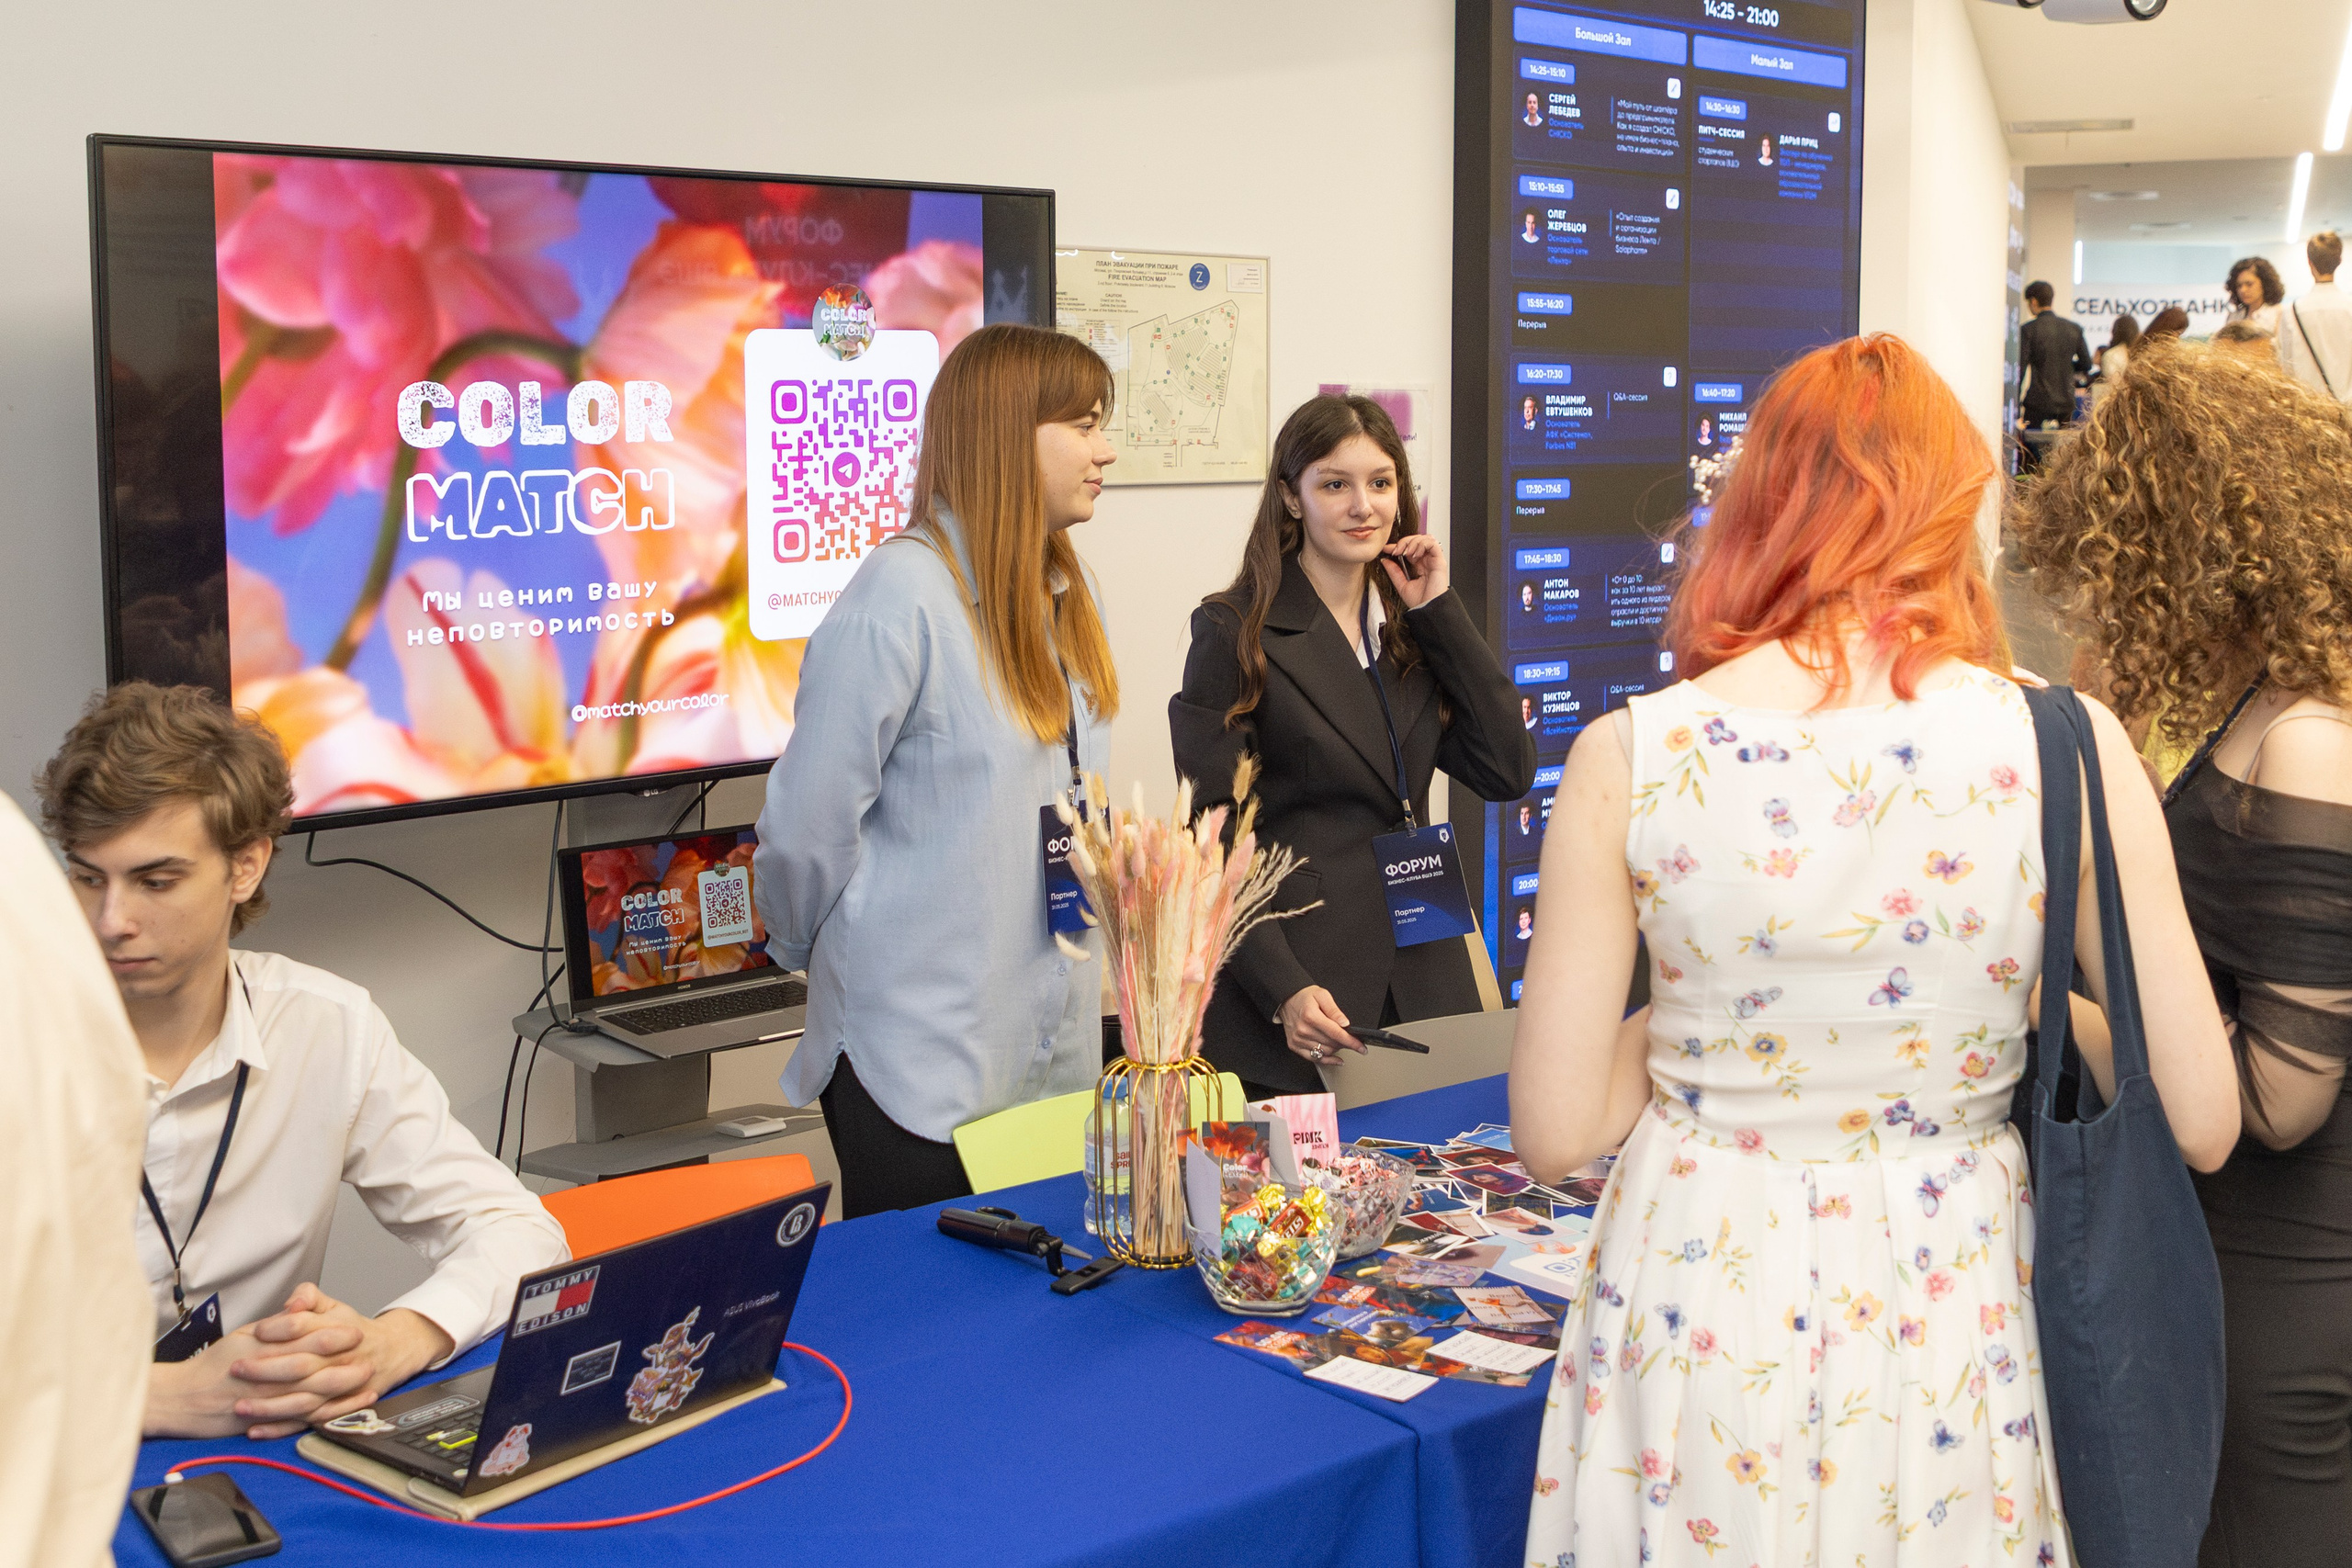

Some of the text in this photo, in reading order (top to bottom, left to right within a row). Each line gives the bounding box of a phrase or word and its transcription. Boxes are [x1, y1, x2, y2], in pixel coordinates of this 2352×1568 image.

[1704, 0, 1736, 20] 14:25
[1747, 6, 1780, 28] 21:00
[1575, 27, 1632, 47] Большой Зал
[1750, 53, 1794, 72] Малый Зал
[1529, 64, 1566, 78] 14:25-15:10
[1548, 93, 1577, 106] СЕРГЕЙ
[1548, 106, 1581, 118] ЛЕБЕДЕВ
[1698, 125, 1746, 139] ПИТЧ-СЕССИЯ
[1779, 134, 1818, 149] ДАРЬЯ ПРИЦ
[1528, 180, 1566, 194] 15:10-15:55
[1547, 209, 1566, 220] ОЛЕГ
[1547, 220, 1588, 233] ЖЕРЕБЦОВ
[1113, 261, 1145, 269] ЭВАКУАЦИИ
[1157, 263, 1179, 271] ПОЖАРЕ
[1195, 271, 1204, 283] Z
[1526, 298, 1565, 310] 15:55-16:20
[820, 308, 867, 322] COLOR
[823, 323, 865, 337] MATCH
[1518, 319, 1547, 331] Перерыв
[1526, 368, 1564, 379] 16:20-17:30
[1545, 394, 1587, 406] ВЛАДИМИР
[1702, 388, 1736, 399] 16:40-17:20
[397, 379, 674, 448] COLOR
[1545, 406, 1593, 417] ЕВТУШЕНКОВ
[1719, 412, 1747, 423] МИХАИЛ
[1526, 483, 1562, 494] 17:30-17:45
[405, 467, 675, 542] MATCH
[1516, 505, 1545, 516] Перерыв
[1523, 553, 1562, 564] 17:45-18:30
[1544, 578, 1569, 589] АНТОН
[422, 581, 658, 613] Мы ценим вашу
[1544, 589, 1580, 601] МАКАРОВ
[407, 608, 675, 647] неповторимость
[1523, 666, 1561, 679] 18:30-19:15
[1543, 690, 1572, 703] ВИКТОР
[571, 693, 730, 723] @matchyourcolor
[1543, 701, 1580, 714] КУЗНЕЦОВ
[1385, 853, 1443, 877] ФОРУМ
[1387, 874, 1422, 886] БИЗНЕС-КЛУБА
[620, 887, 684, 912] COLOR
[1050, 890, 1078, 902] Партнер
[1394, 906, 1426, 918] Партнер
[623, 908, 685, 932] MATCH
[626, 941, 687, 956] неповторимость
[640, 938, 663, 946] ценим
[1293, 1131, 1323, 1145] PINK
[529, 1269, 594, 1298] TOMMY
[517, 1302, 588, 1333] EDISON
